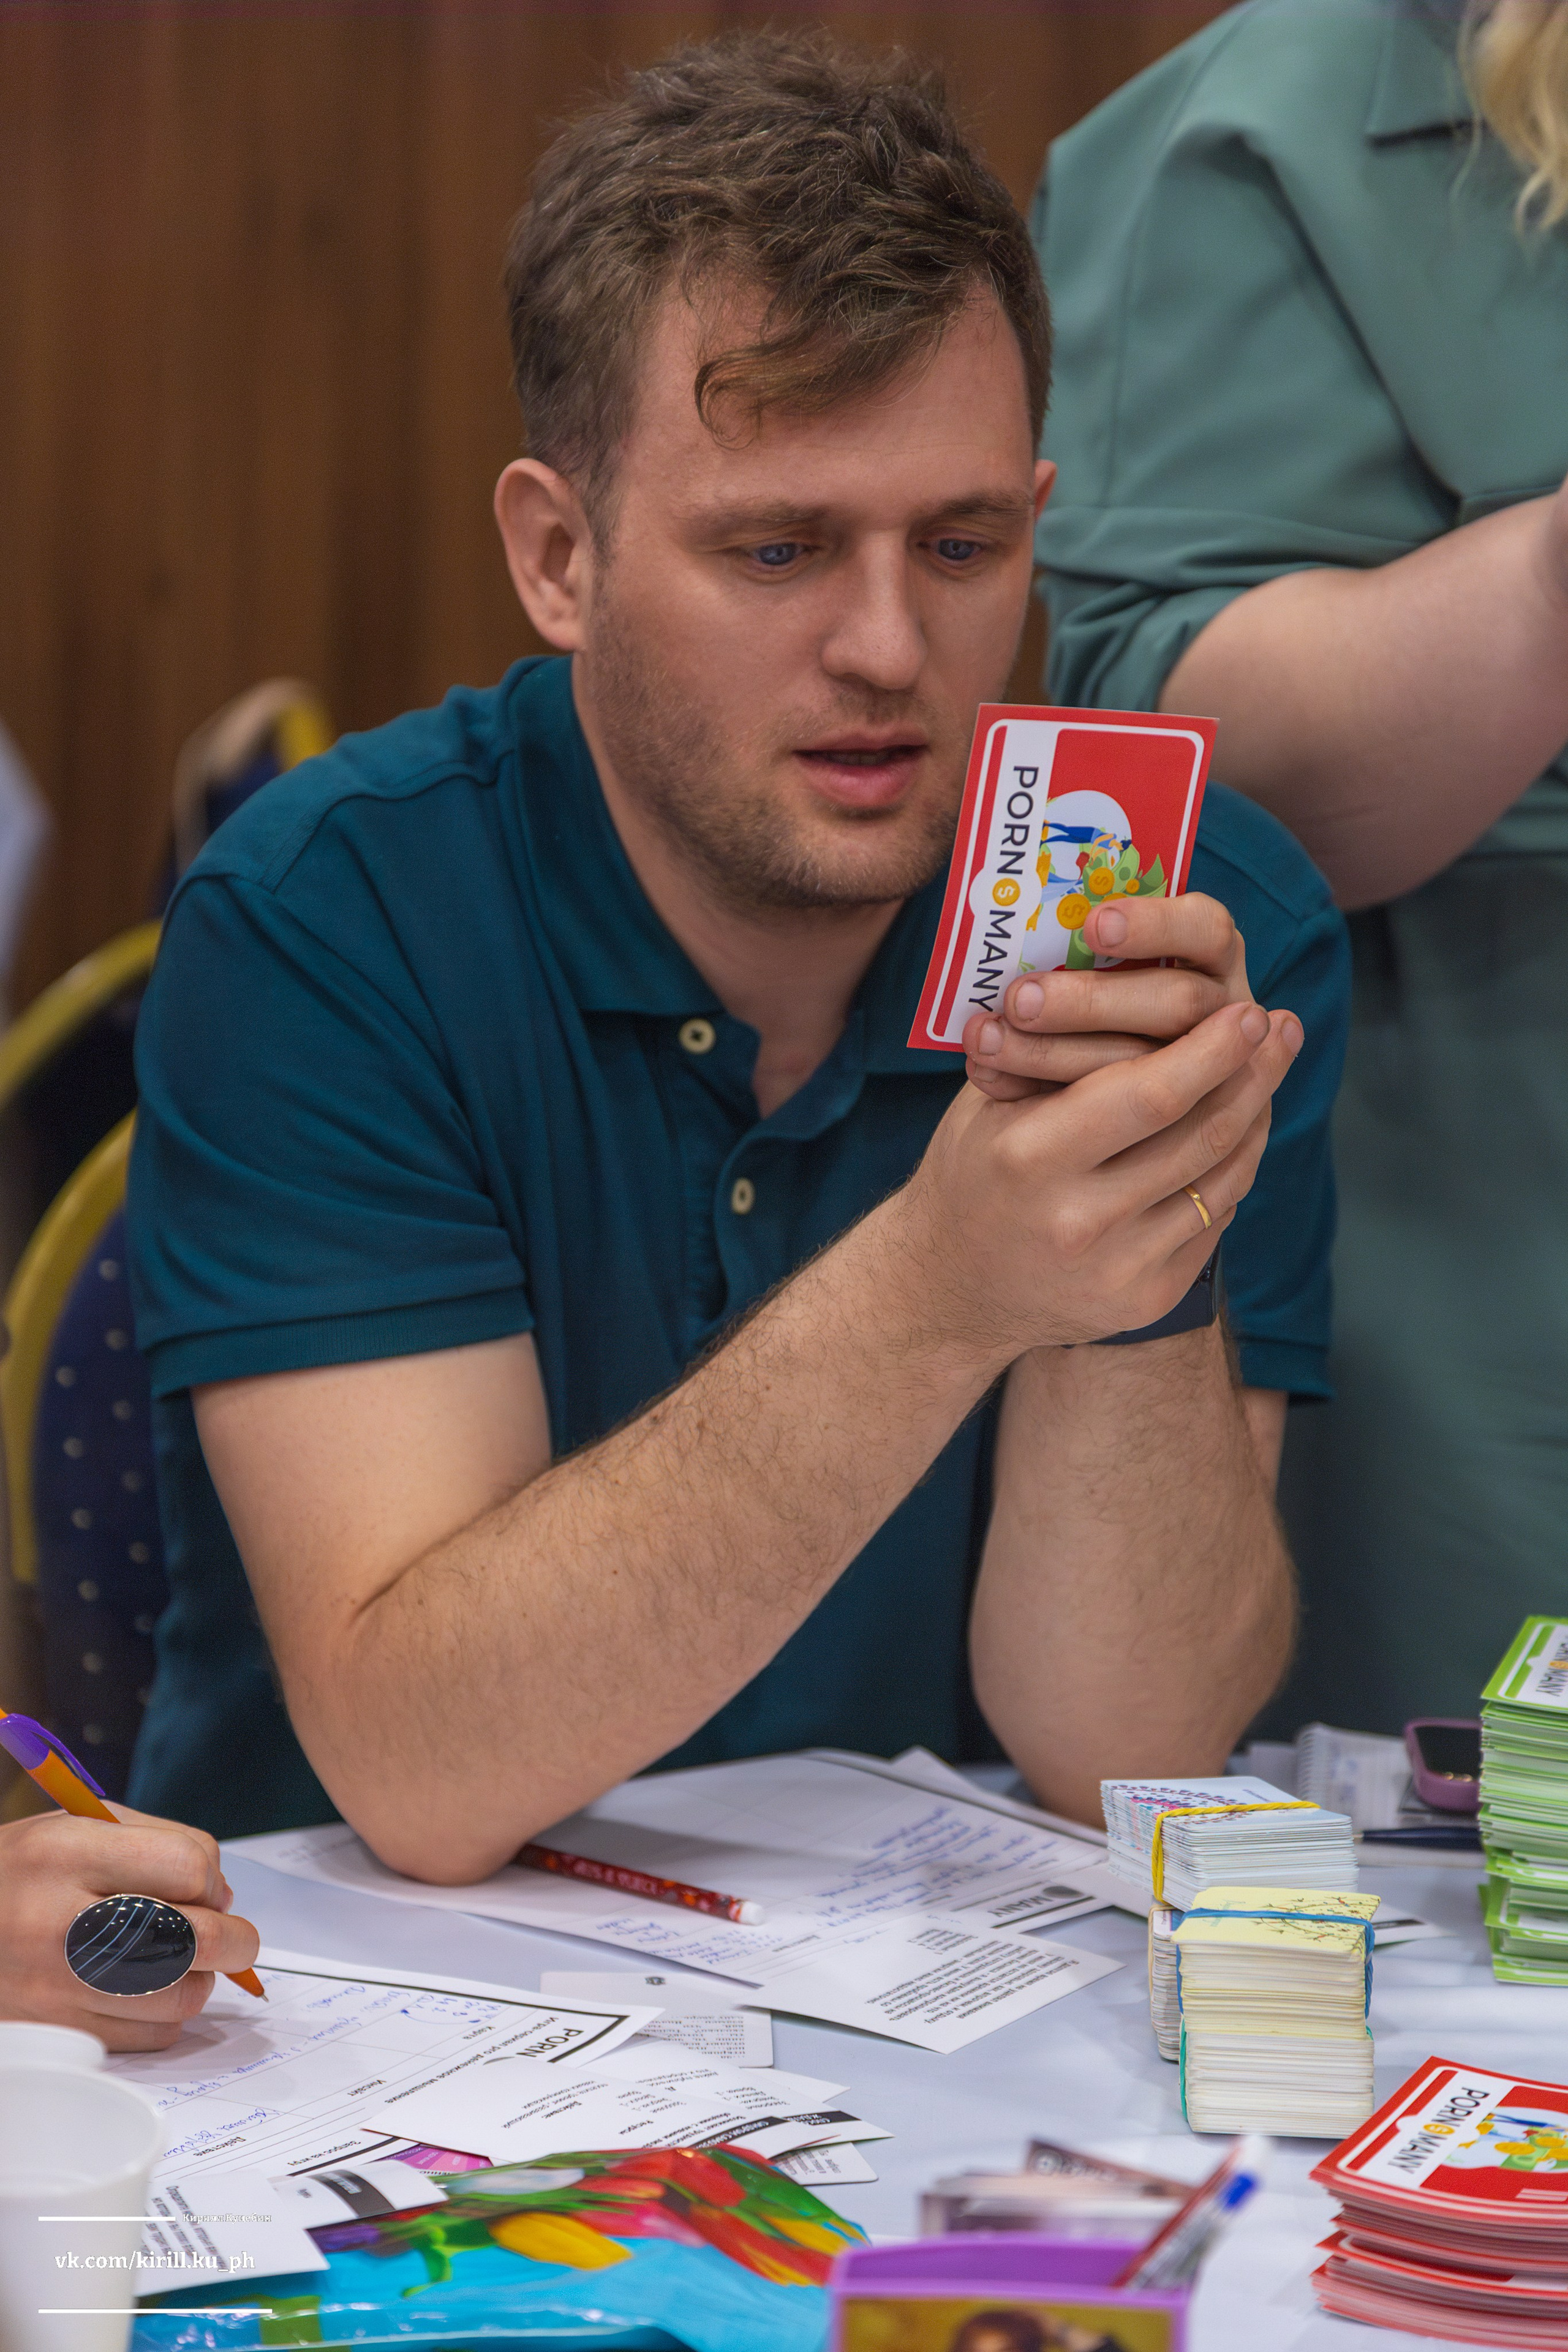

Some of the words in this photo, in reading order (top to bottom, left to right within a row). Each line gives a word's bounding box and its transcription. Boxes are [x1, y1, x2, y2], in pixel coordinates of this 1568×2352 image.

[462, 2026, 496, 2040] Карта
[347, 2079, 387, 2097] Инсайт
[385, 2078, 439, 2103] мышление
[194, 2136, 246, 2157] Действие
[324, 2141, 361, 2154] Запрос
